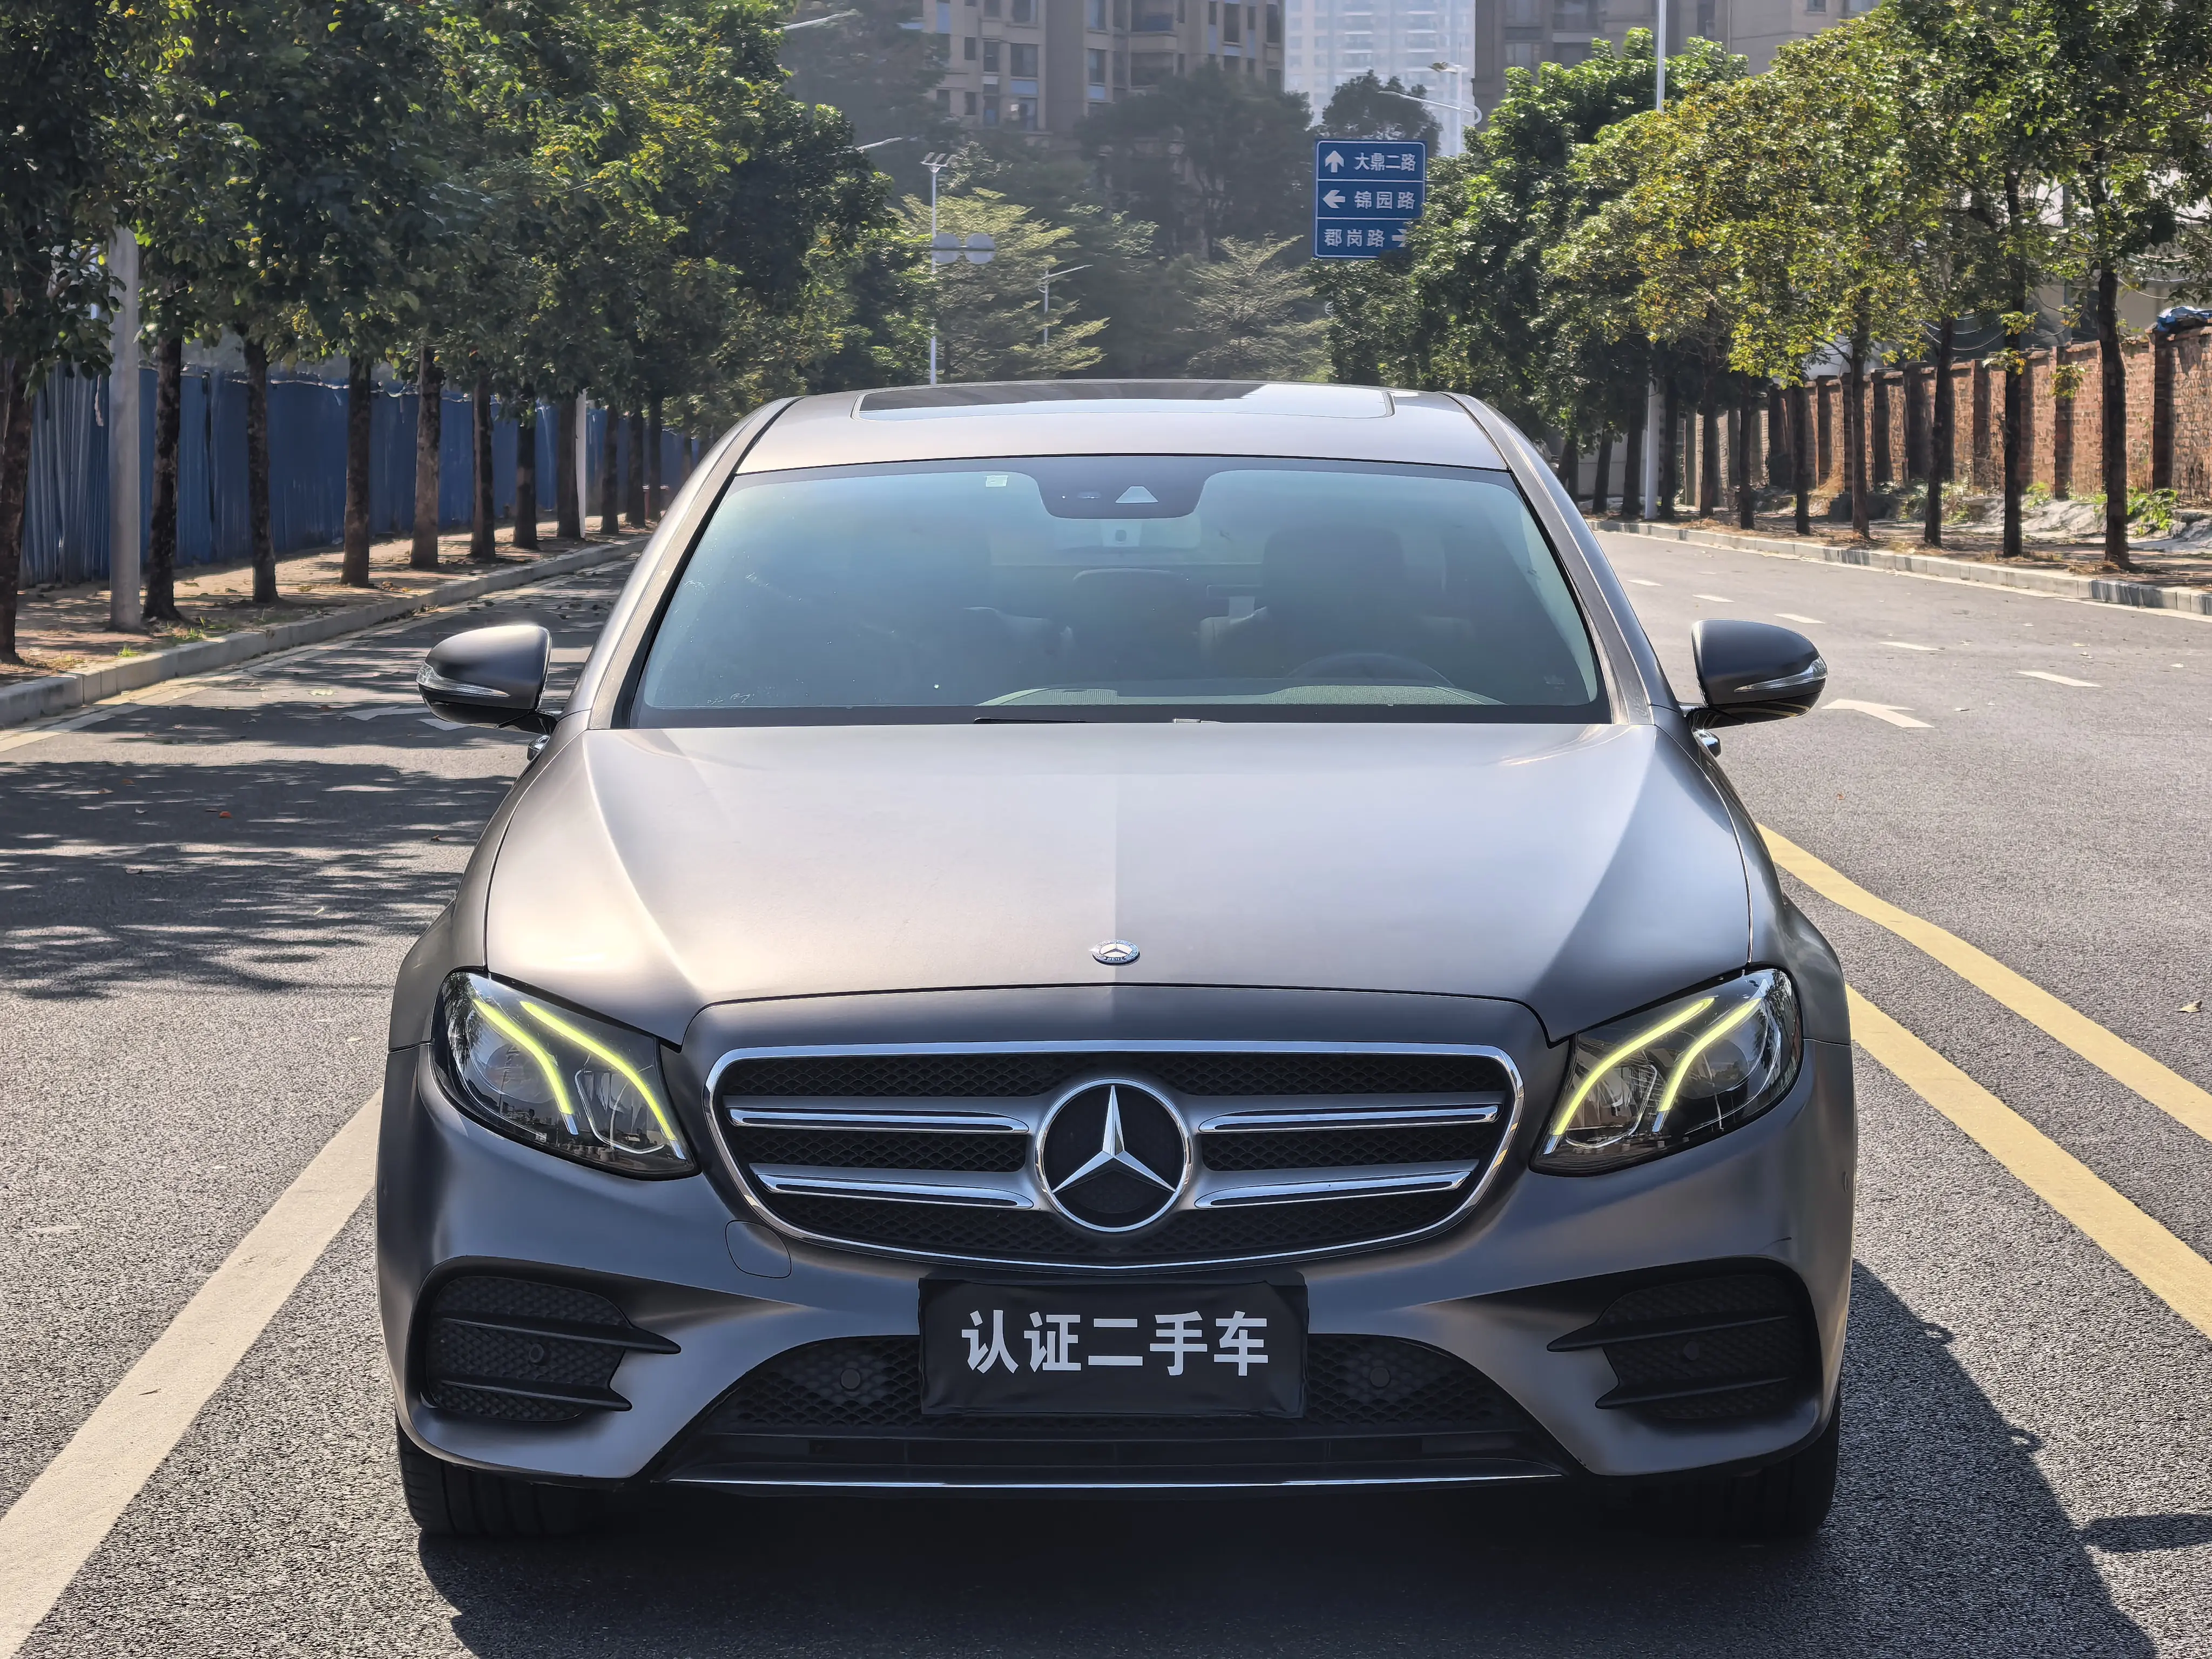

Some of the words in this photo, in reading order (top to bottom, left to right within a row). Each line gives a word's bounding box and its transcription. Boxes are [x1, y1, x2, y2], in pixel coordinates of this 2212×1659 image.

[1354, 152, 1416, 171] 大鼎二路
[1354, 191, 1415, 210] 锦园路
[1324, 228, 1385, 247] 郡岗路
[961, 1310, 1269, 1375] 认证二手车
